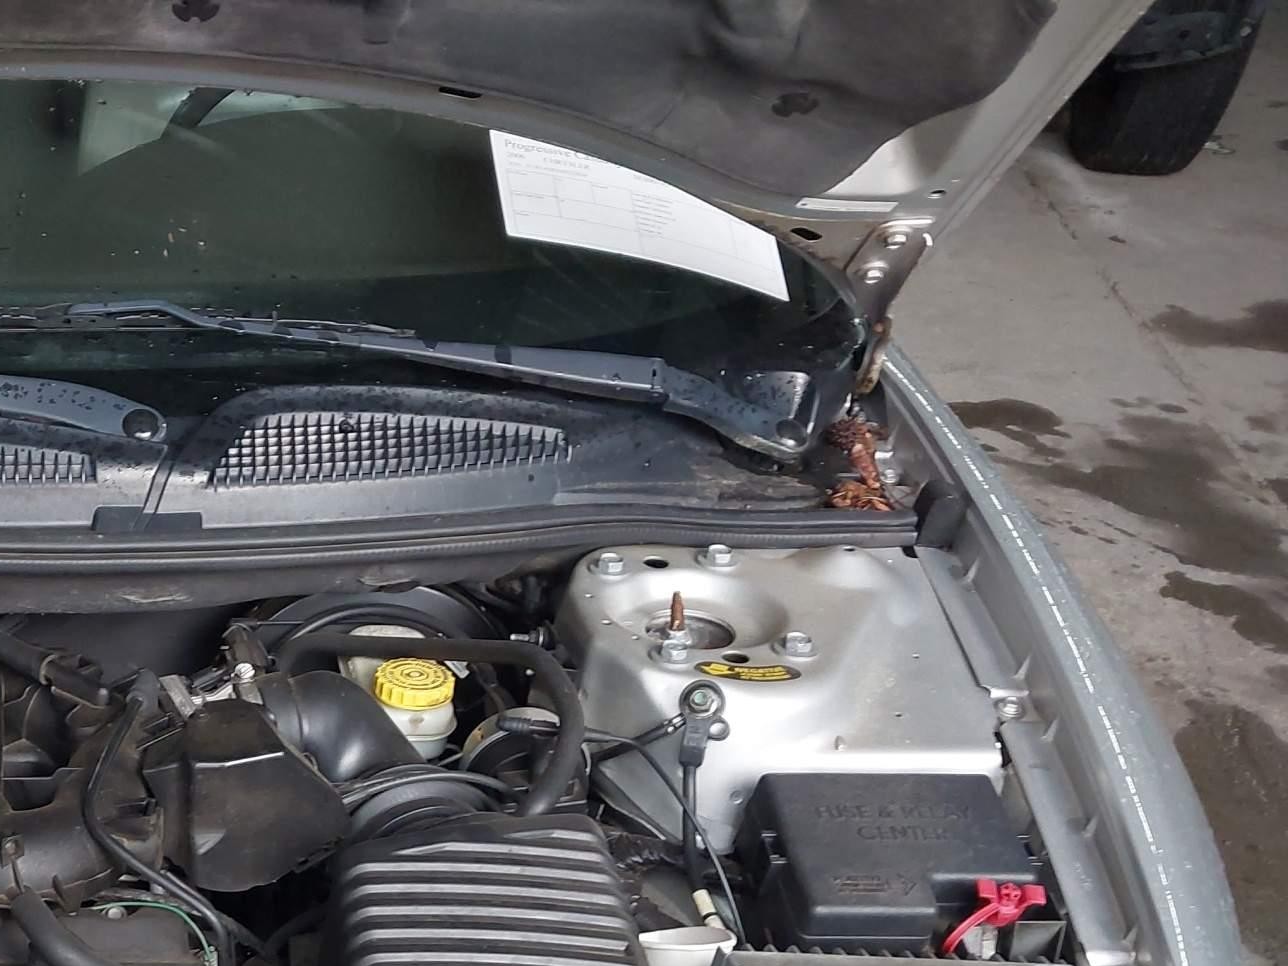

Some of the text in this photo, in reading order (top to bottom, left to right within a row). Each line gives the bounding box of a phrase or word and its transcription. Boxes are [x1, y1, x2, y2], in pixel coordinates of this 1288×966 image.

[814, 804, 872, 818] FUSE
[901, 804, 969, 820] RELAY
[856, 824, 948, 840] CENTER
